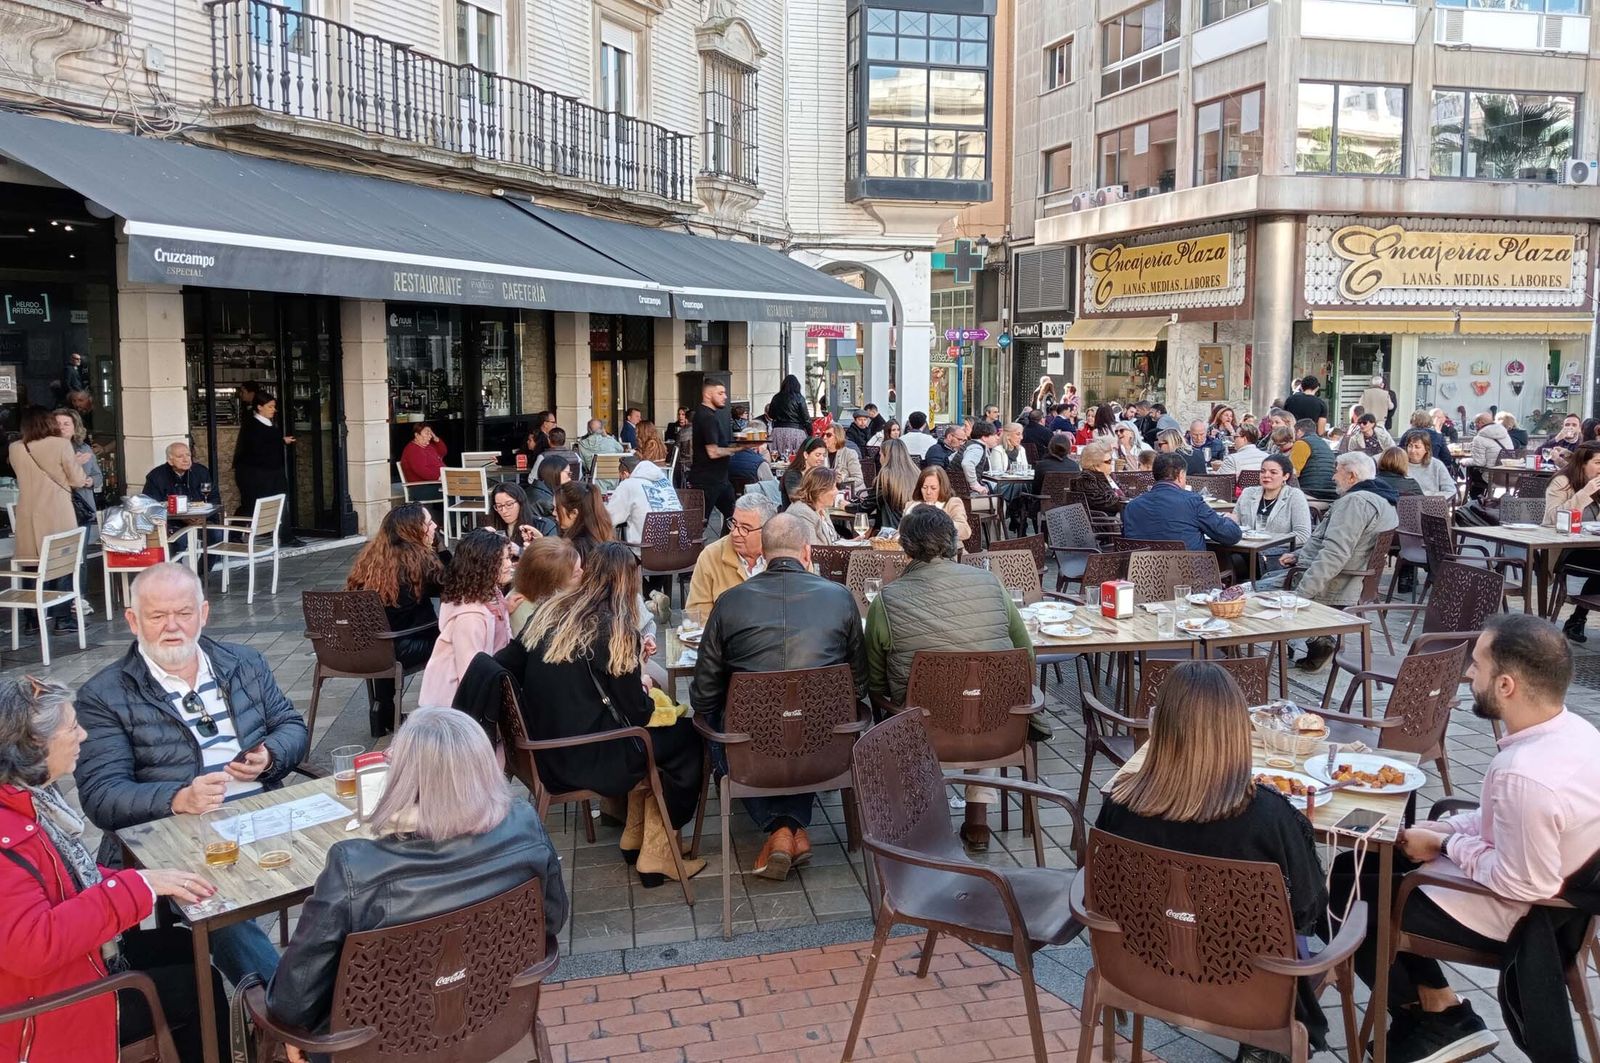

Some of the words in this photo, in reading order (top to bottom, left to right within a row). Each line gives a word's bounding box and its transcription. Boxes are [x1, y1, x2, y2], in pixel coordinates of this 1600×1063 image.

[154, 247, 215, 268] Cruzcampo
[1174, 240, 1227, 265] Plaza
[1494, 236, 1572, 261] Plaza
[166, 266, 204, 277] ESPECIAL
[1403, 272, 1441, 285] LANAS
[1453, 273, 1499, 286] MEDIAS
[1511, 274, 1562, 287] LABORES
[393, 271, 462, 296] RESTAURANTE
[1123, 282, 1146, 295] LANAS
[1150, 280, 1180, 293] MEDIAS
[1184, 275, 1221, 290] LABORES
[1165, 909, 1197, 923] Coca-Cola
[435, 967, 467, 987] Coca-Cola
